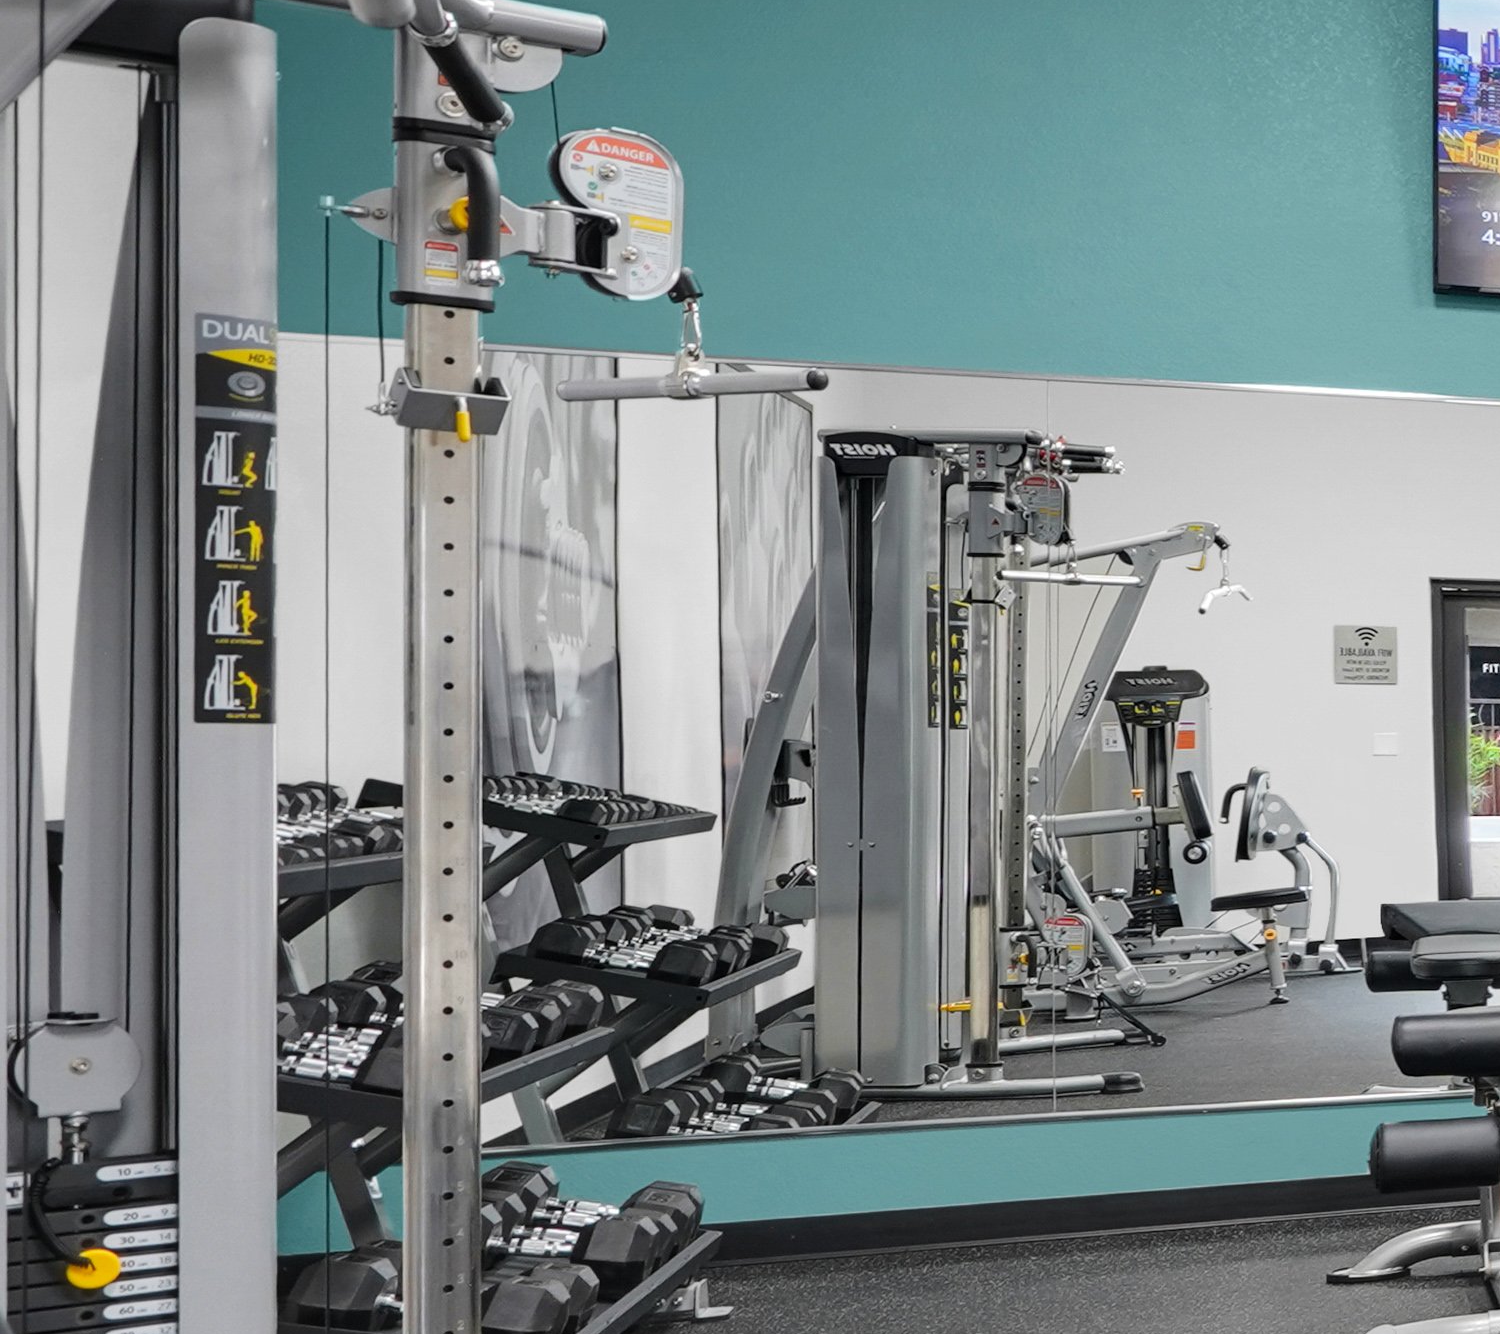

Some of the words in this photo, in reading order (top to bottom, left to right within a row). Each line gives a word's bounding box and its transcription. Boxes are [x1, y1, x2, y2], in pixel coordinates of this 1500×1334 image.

[601, 142, 655, 164] DANGER
[202, 319, 270, 344] DUAL
[117, 1168, 132, 1177] 10
[123, 1211, 139, 1221] 20
[120, 1235, 136, 1245] 30
[119, 1283, 135, 1293] 50
[119, 1305, 135, 1315] 60
